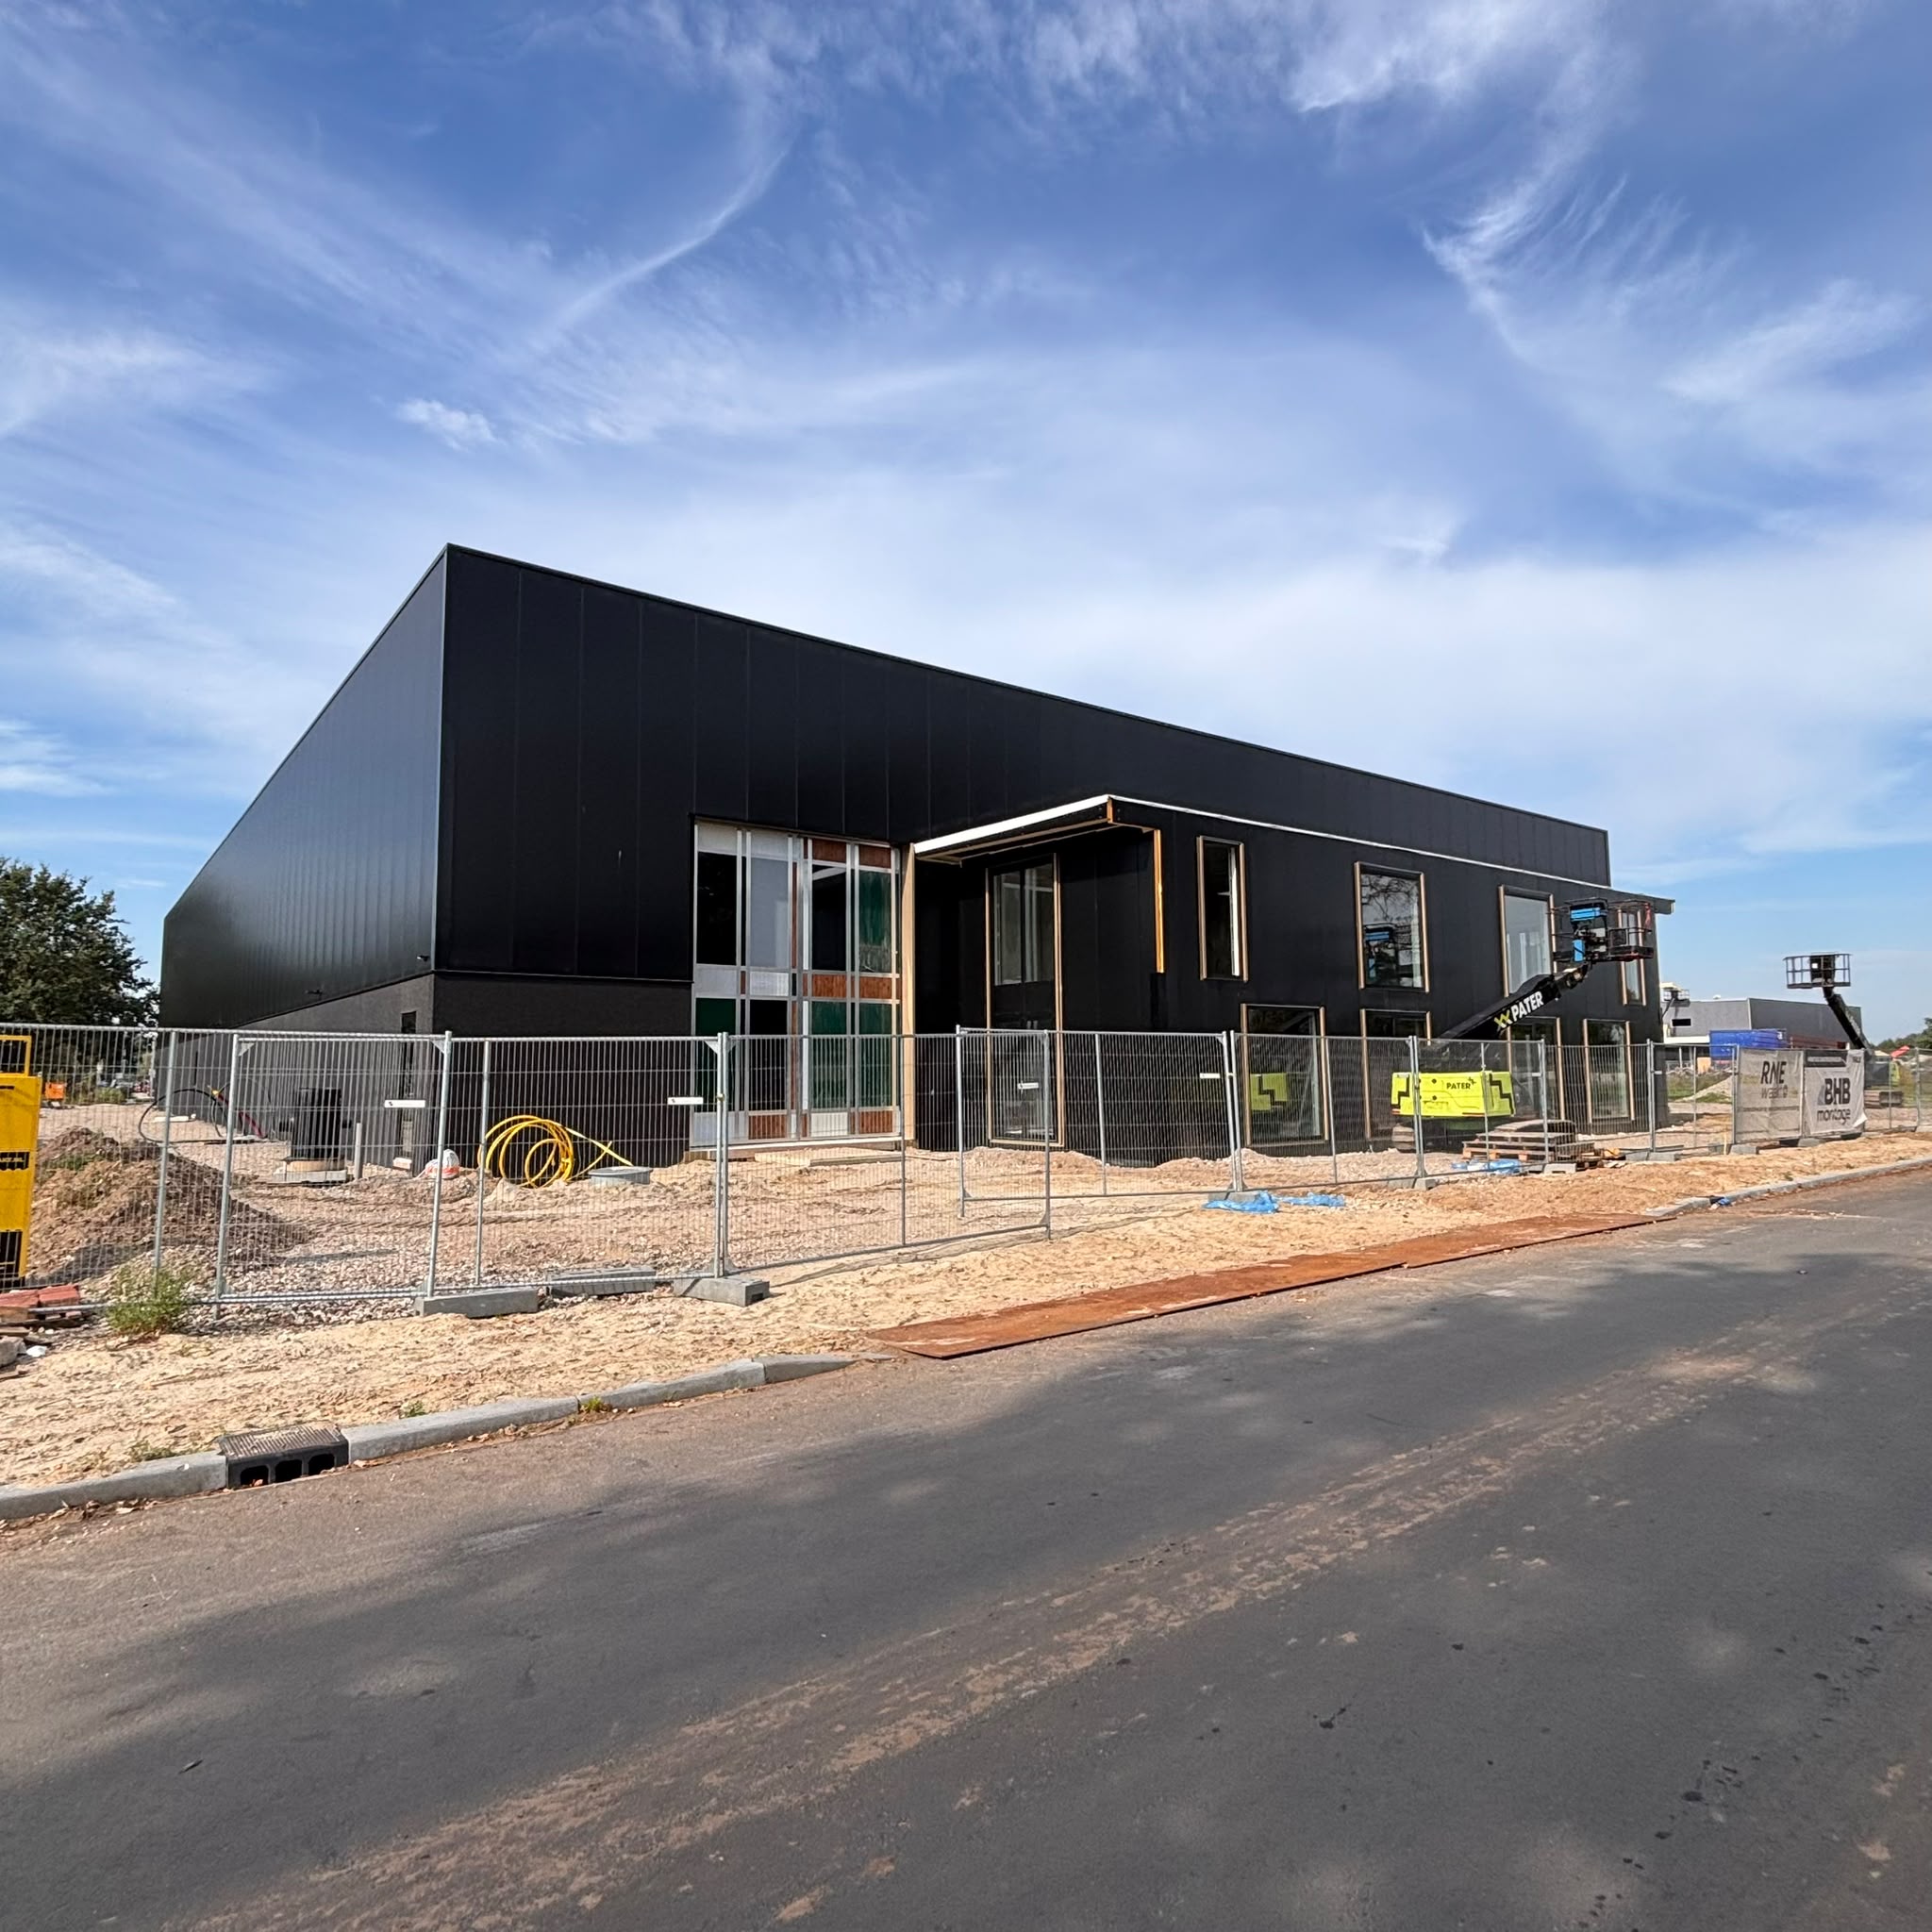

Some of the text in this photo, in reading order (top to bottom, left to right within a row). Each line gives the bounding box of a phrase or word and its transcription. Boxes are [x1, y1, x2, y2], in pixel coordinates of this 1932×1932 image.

[1510, 991, 1544, 1022] PATER
[1824, 1077, 1851, 1105] BHB
[1816, 1108, 1851, 1125] montage
